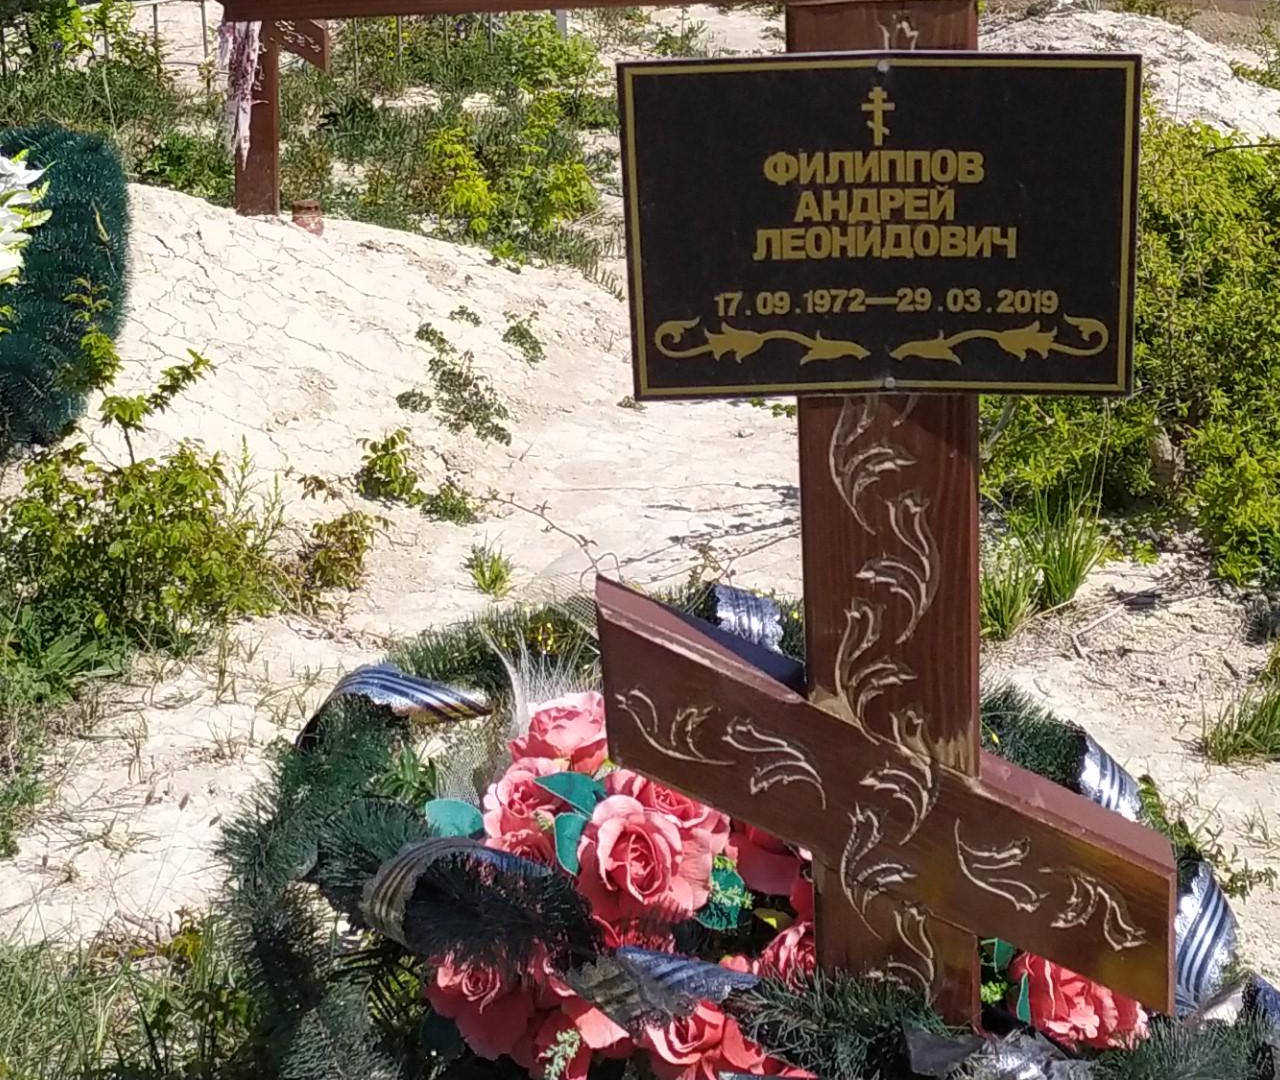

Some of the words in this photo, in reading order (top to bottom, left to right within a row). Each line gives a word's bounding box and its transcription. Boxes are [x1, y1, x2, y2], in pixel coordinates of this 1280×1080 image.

[762, 148, 986, 186] ФИЛИППОВ
[793, 185, 955, 223] АНДРЕЙ
[752, 224, 1017, 261] ЛЕОНИДОВИЧ
